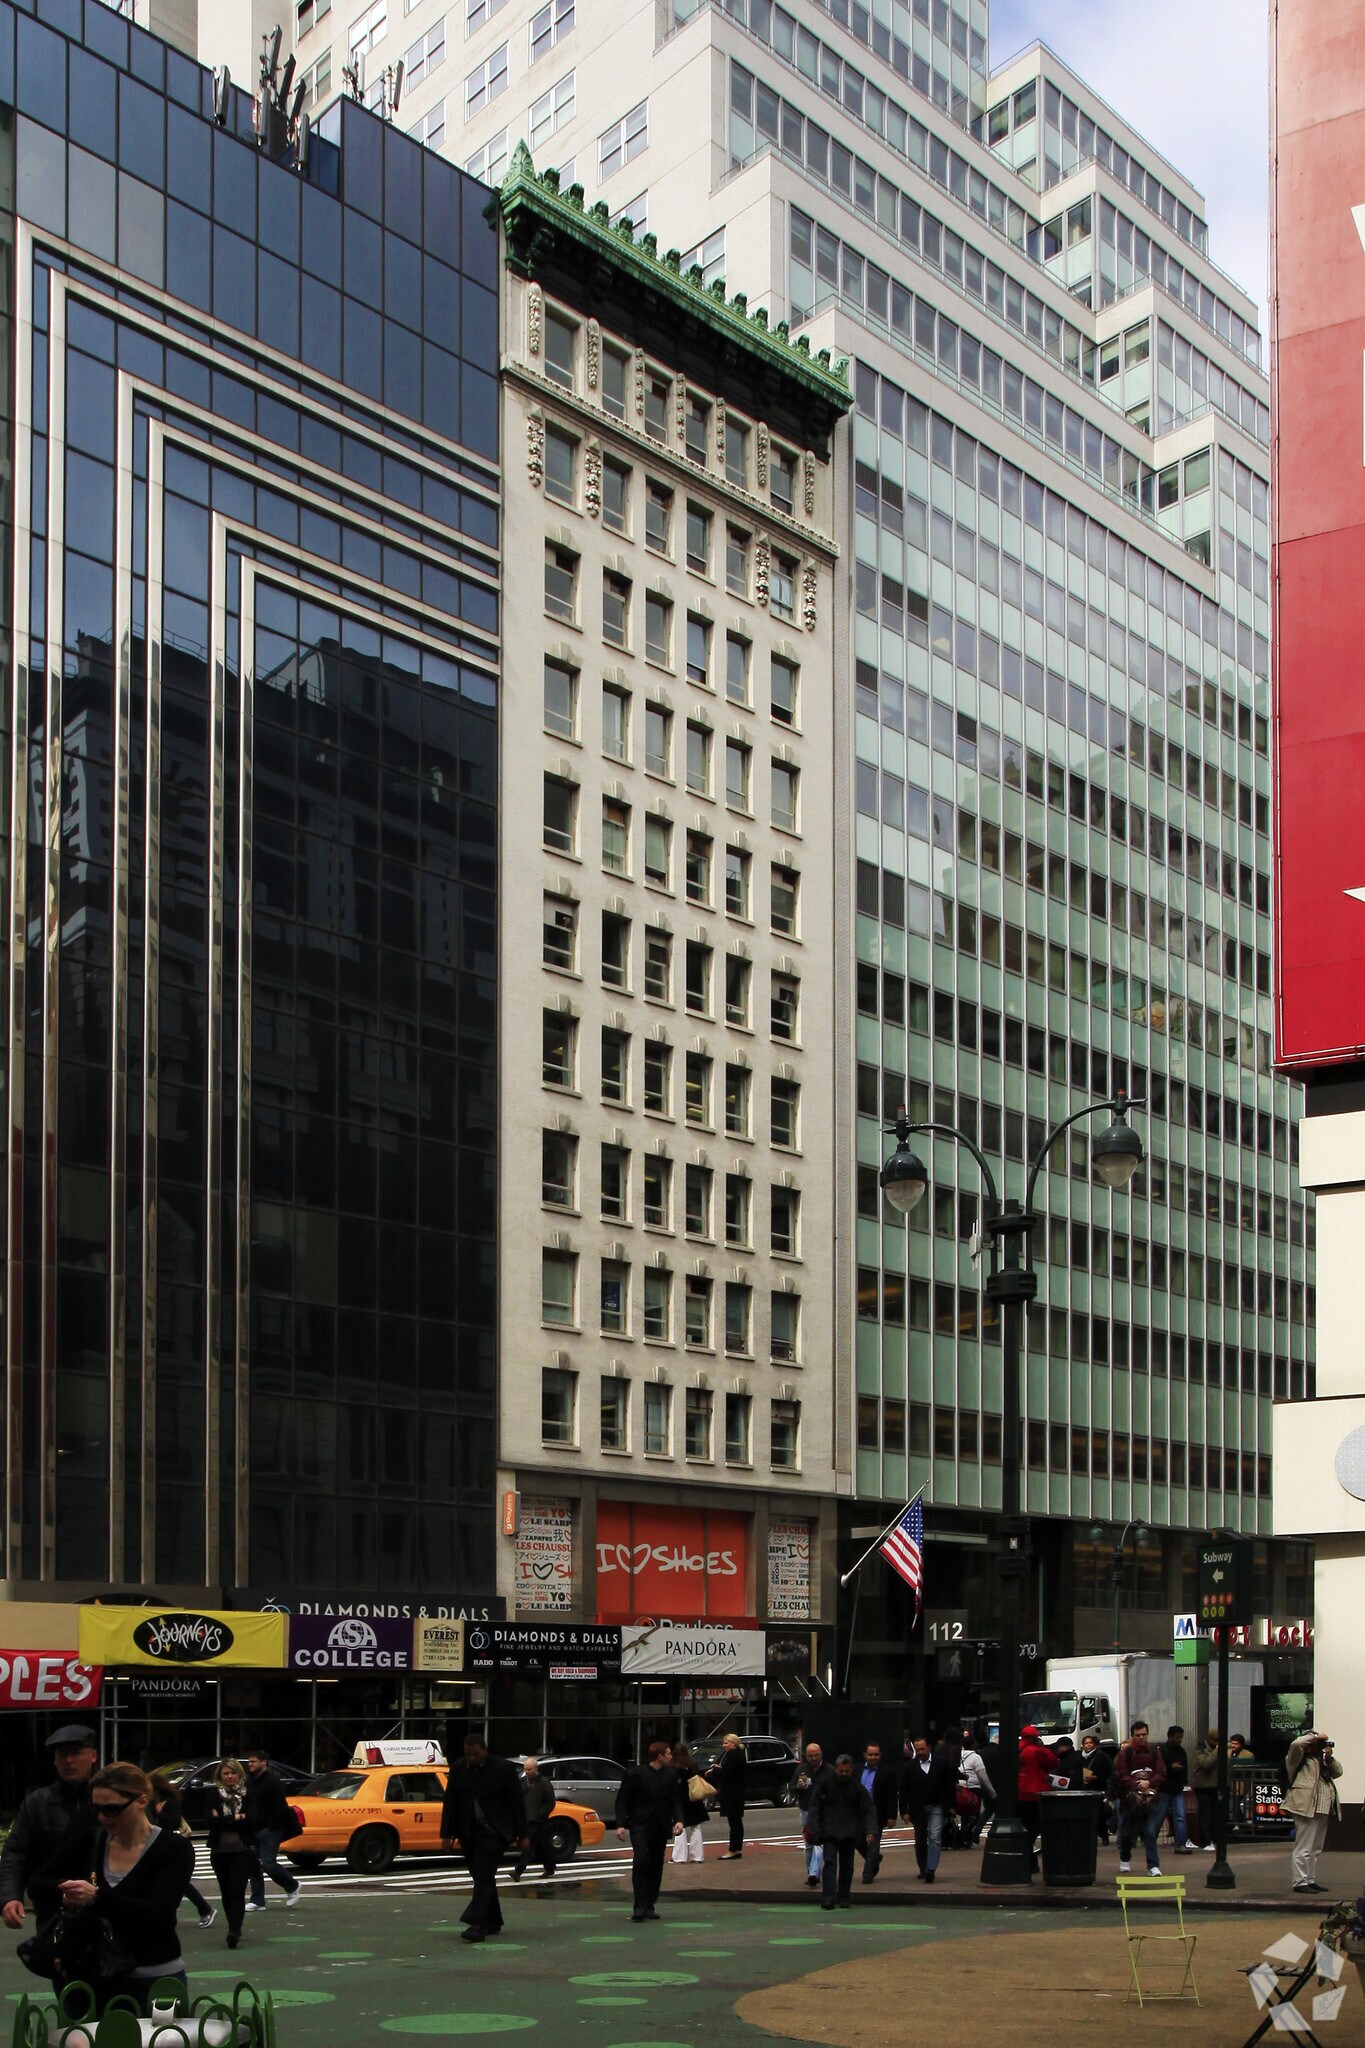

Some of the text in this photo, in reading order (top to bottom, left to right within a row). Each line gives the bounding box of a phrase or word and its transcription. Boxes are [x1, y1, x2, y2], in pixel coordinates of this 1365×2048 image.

[516, 1541, 533, 1550] LES
[596, 1543, 737, 1575] I SHOES
[1203, 1552, 1233, 1564] Subway
[550, 1592, 566, 1602] YO
[773, 1601, 788, 1609] LES
[300, 1603, 489, 1621] DIAMONDS & DIALS
[328, 1619, 377, 1649] ASA
[424, 1630, 459, 1640] EVEREST
[494, 1631, 618, 1644] DIAMONDS & DIALS
[929, 1622, 963, 1641] 112
[1212, 1625, 1250, 1645] oot
[665, 1640, 736, 1656] PANDORA
[295, 1649, 407, 1667] COLLEGE
[132, 1679, 201, 1691] PANDORA
[1255, 1785, 1268, 1794] 34
[1255, 1795, 1285, 1804] Statio
